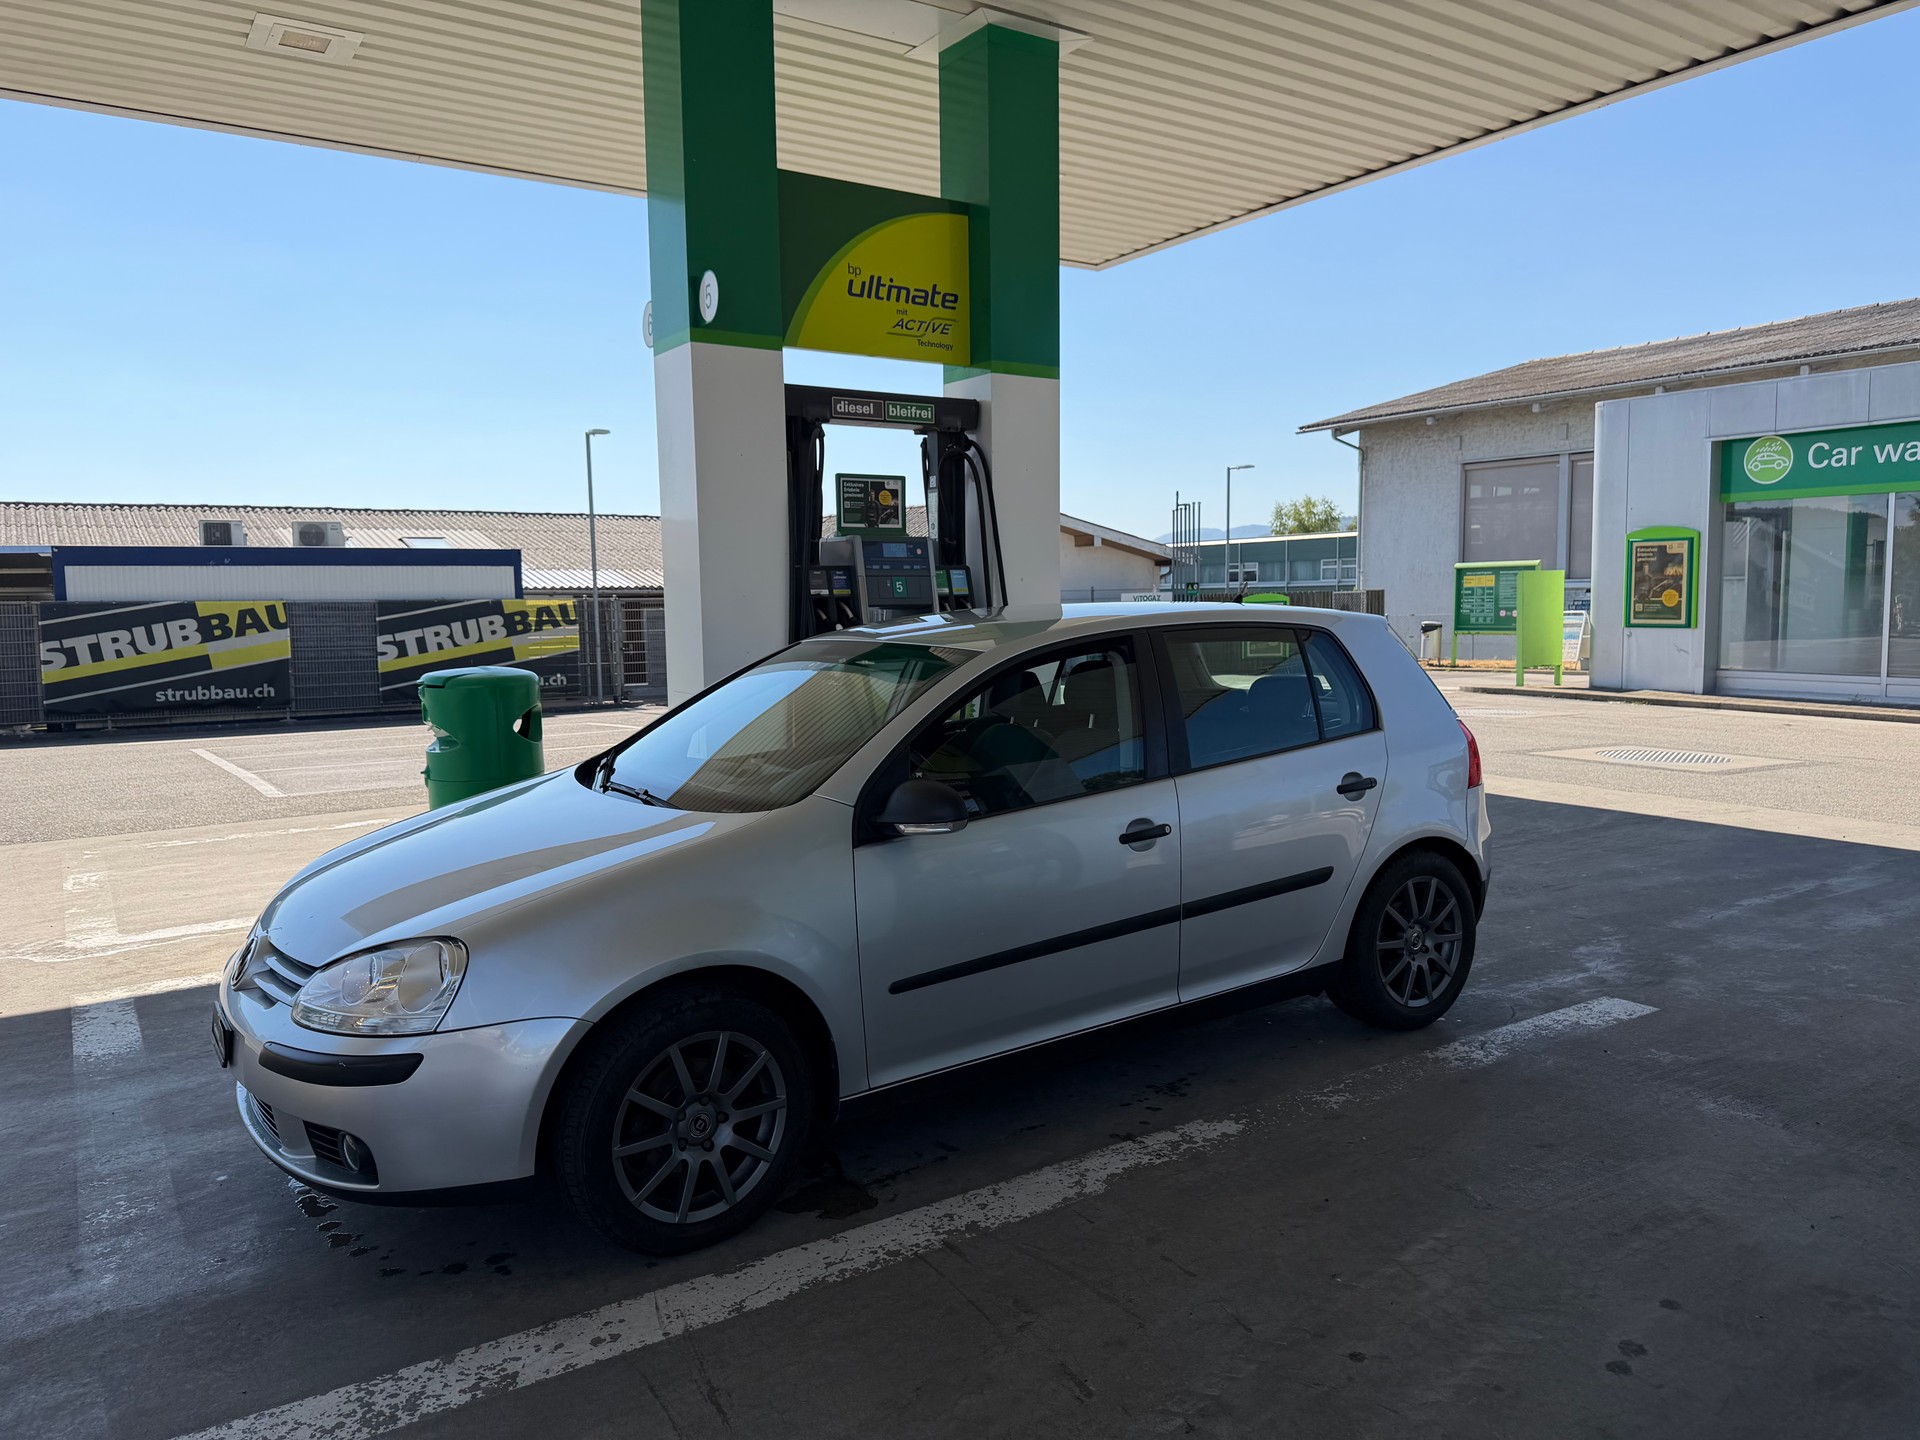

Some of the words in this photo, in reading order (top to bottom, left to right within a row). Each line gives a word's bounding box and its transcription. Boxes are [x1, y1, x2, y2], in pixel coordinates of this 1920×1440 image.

[847, 262, 861, 277] bp
[705, 283, 712, 310] 5
[847, 274, 959, 310] ultimate
[896, 308, 908, 316] mit
[892, 318, 953, 335] ACTIVE
[917, 339, 954, 351] Technology
[836, 401, 874, 415] diesel
[889, 404, 932, 419] bleifrei
[1807, 442, 1863, 469] Car
[895, 581, 904, 593] 5
[1133, 594, 1161, 602] VITOGAZ
[155, 683, 275, 702] strubbau.ch
